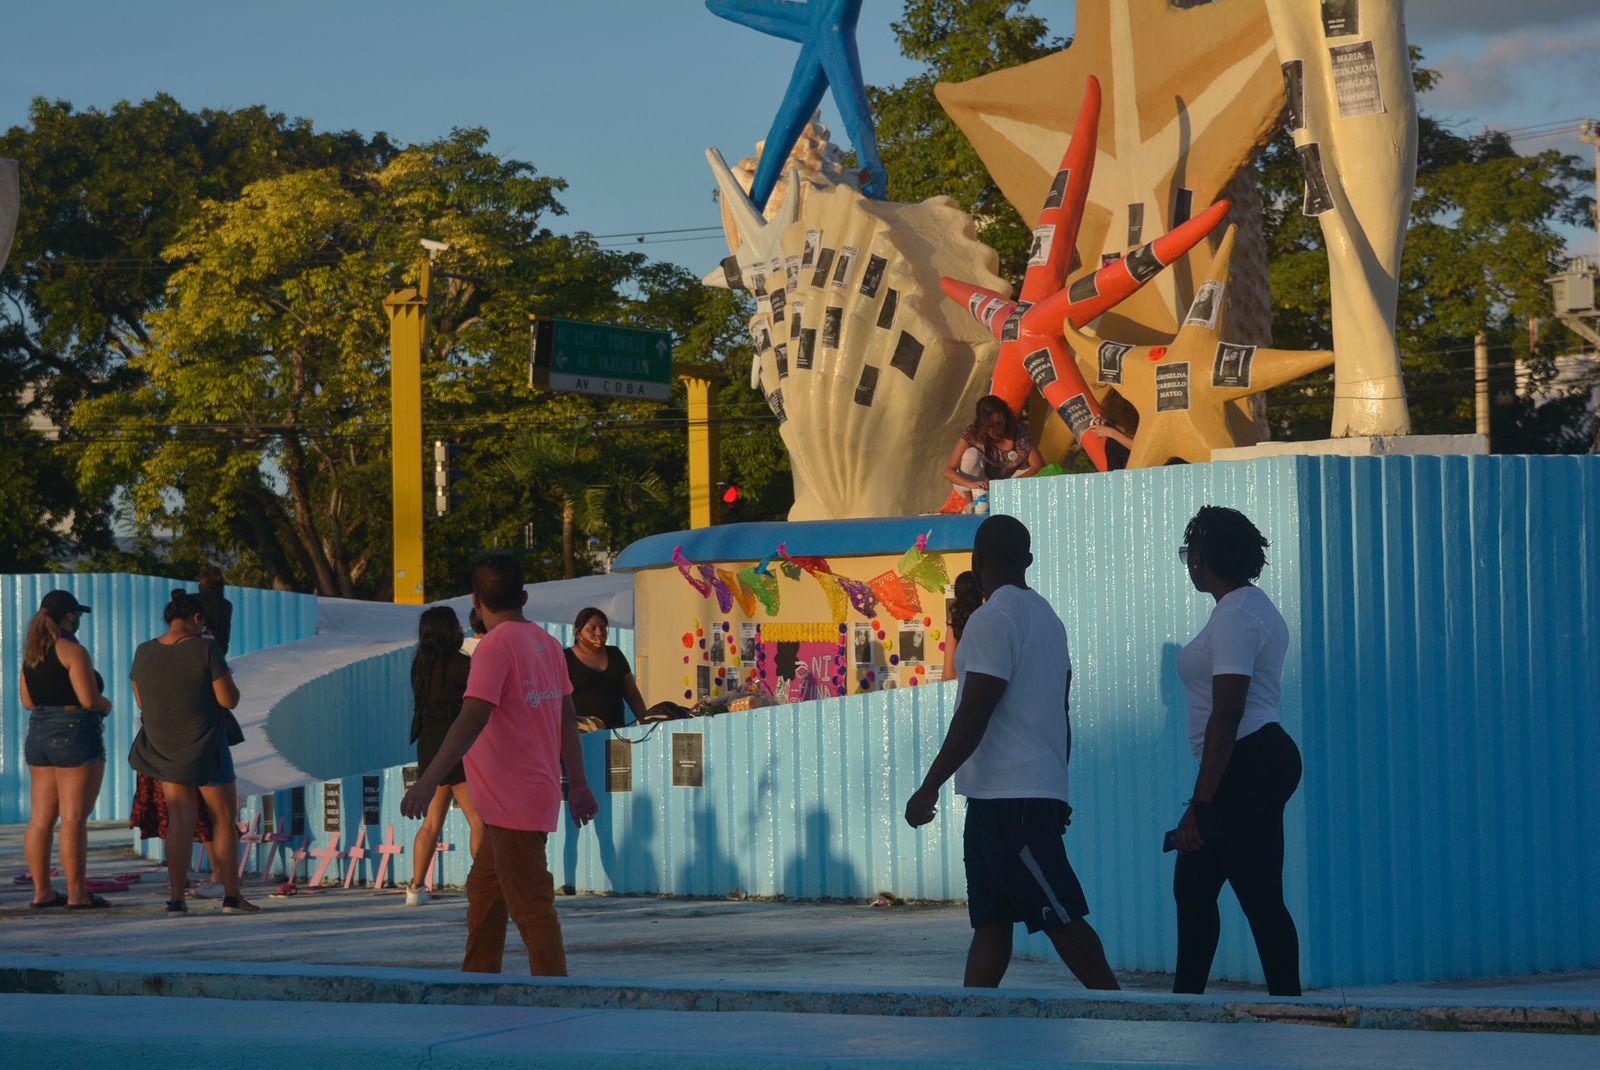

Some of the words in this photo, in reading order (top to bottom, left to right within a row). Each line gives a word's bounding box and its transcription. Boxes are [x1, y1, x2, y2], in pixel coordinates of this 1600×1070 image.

[1337, 52, 1364, 63] MARIA
[1157, 372, 1187, 381] GRISELDA
[576, 378, 591, 390] AV.
[604, 380, 645, 396] COBA
[1160, 390, 1183, 398] MATEO
[811, 655, 832, 681] NI
